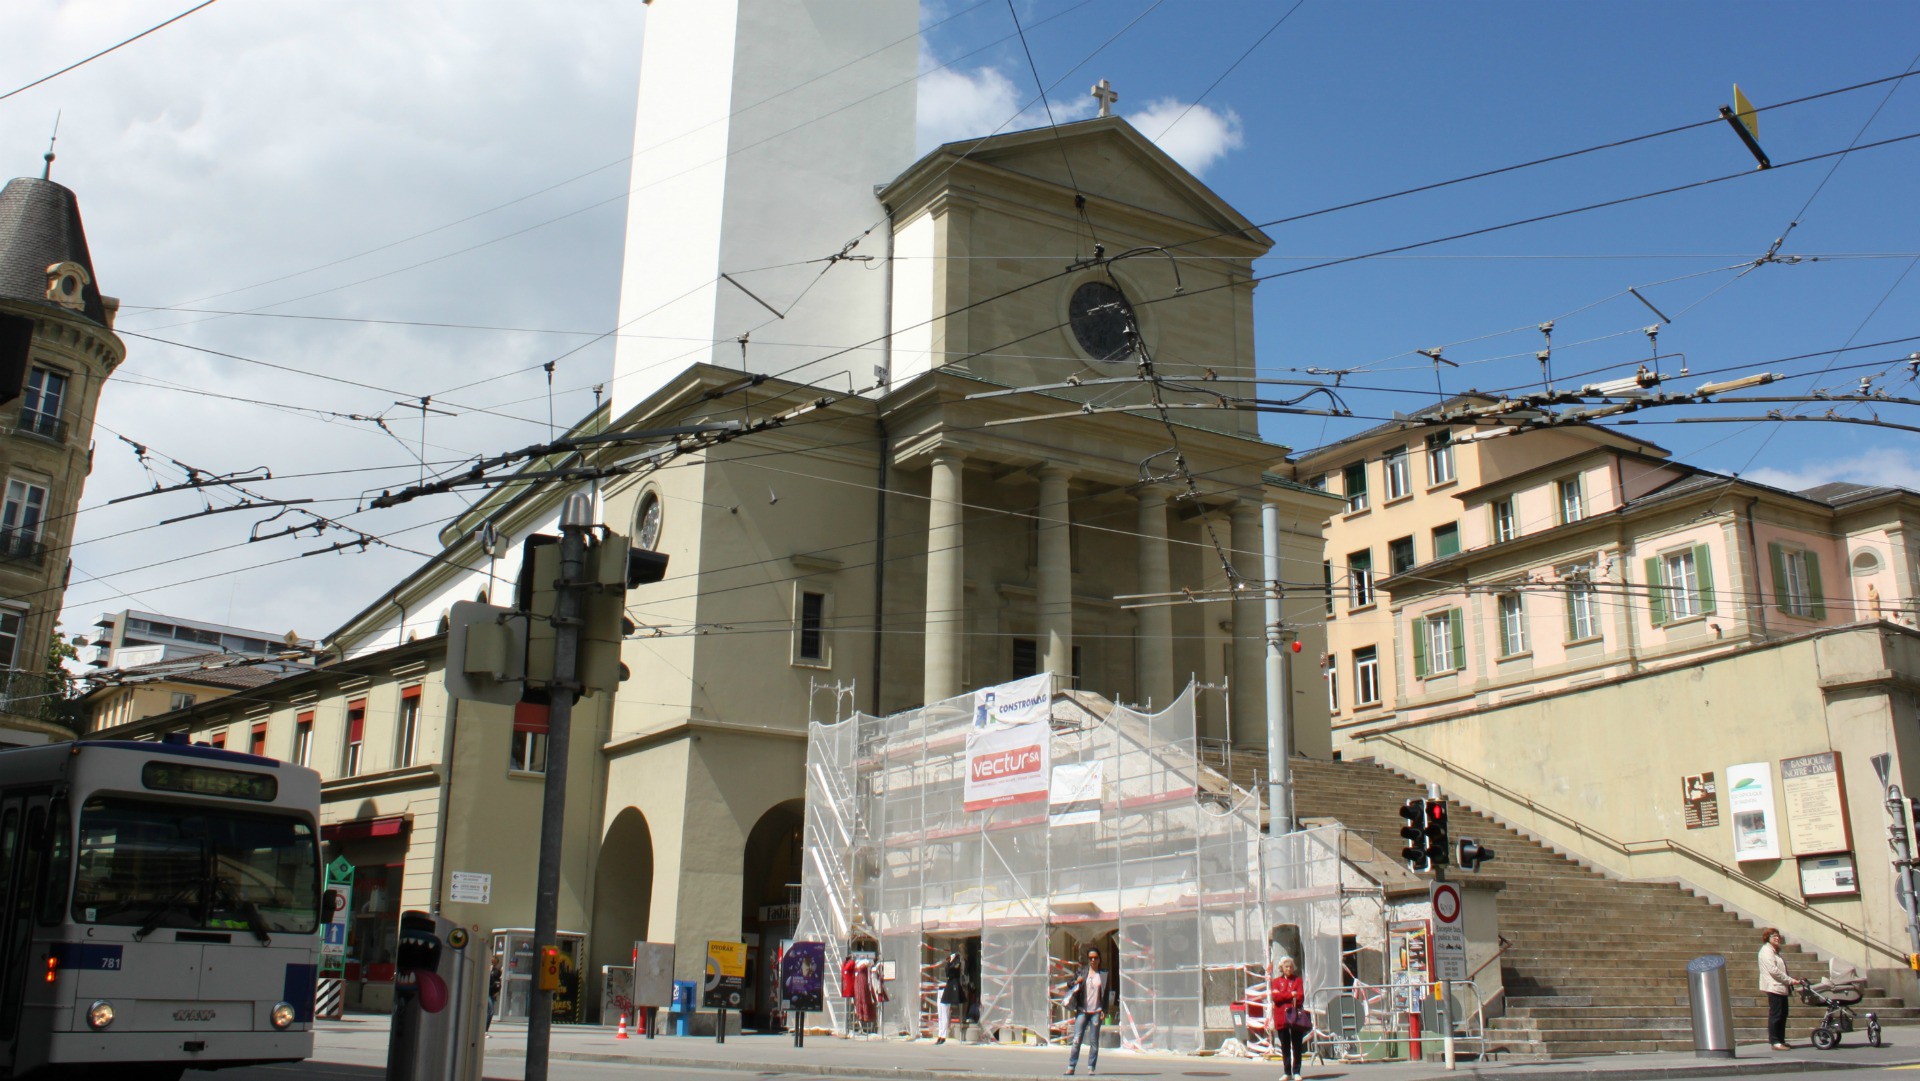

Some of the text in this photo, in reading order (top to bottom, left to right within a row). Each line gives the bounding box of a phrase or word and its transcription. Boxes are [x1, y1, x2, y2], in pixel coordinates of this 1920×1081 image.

[974, 752, 1039, 777] vectur SA
[1790, 756, 1825, 768] BASILIQUE
[1785, 767, 1808, 777] NOTRE
[1812, 763, 1833, 774] DAME
[87, 927, 94, 938] C
[101, 957, 121, 969] 781
